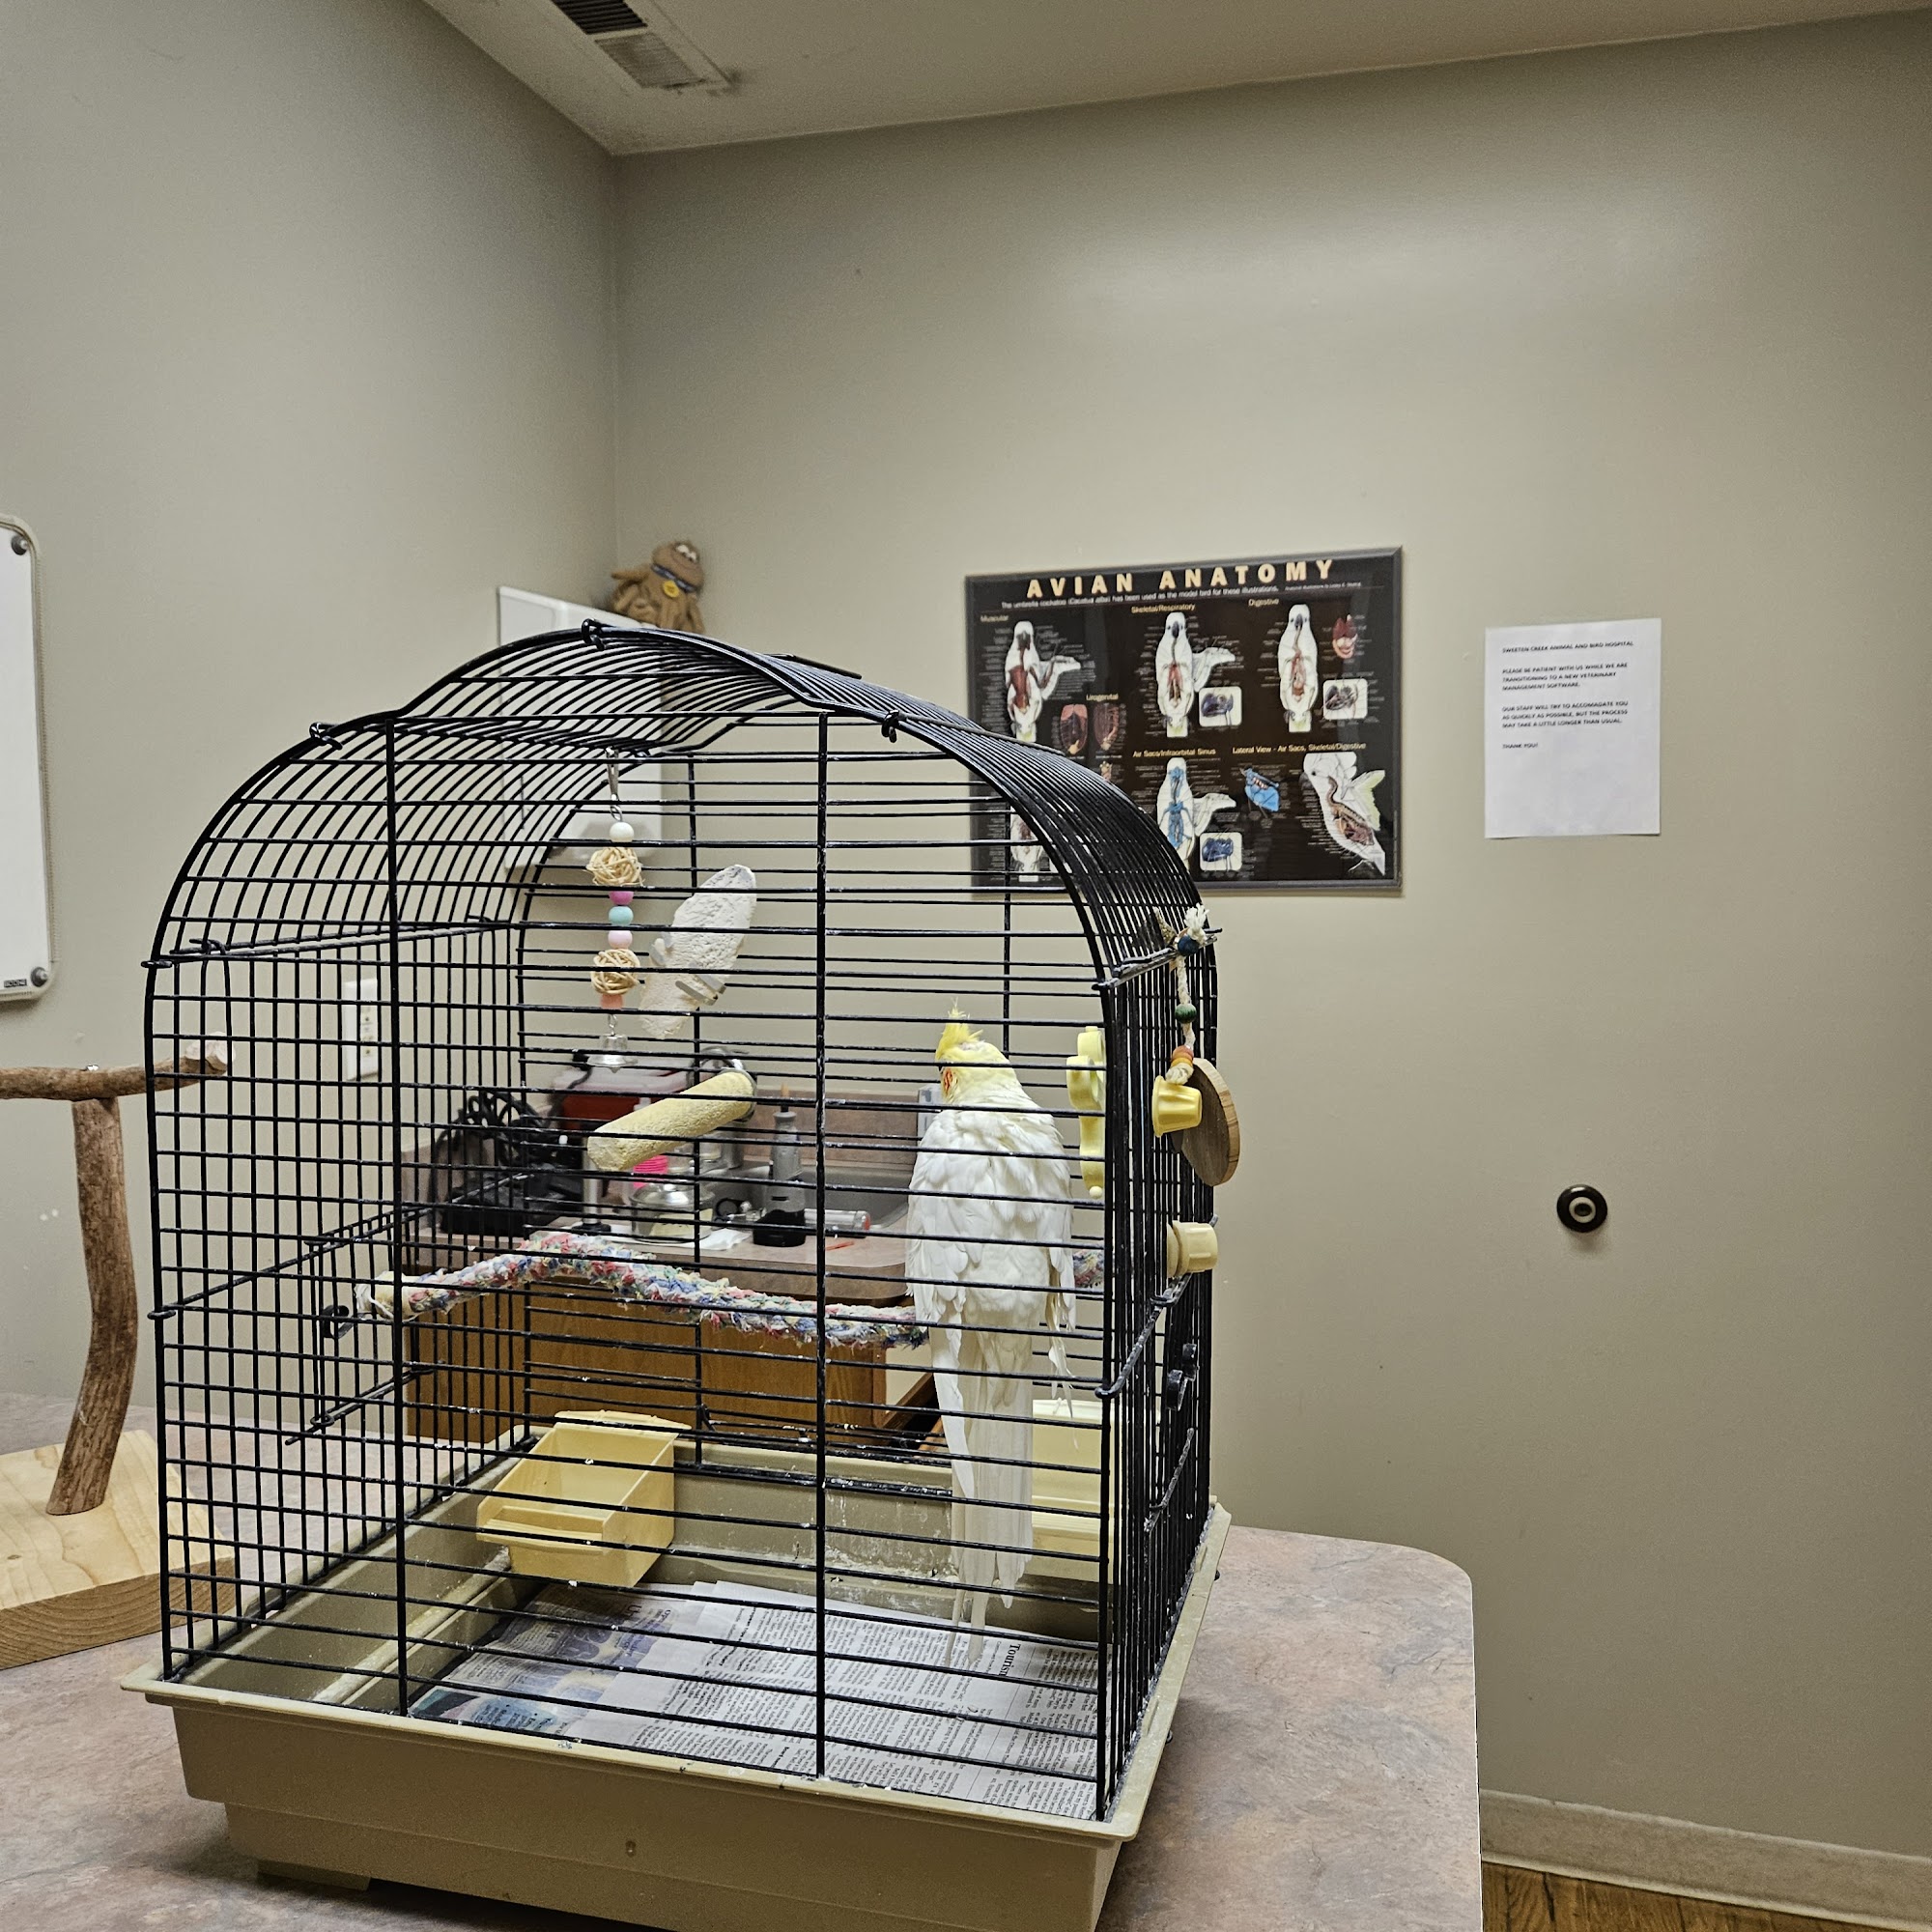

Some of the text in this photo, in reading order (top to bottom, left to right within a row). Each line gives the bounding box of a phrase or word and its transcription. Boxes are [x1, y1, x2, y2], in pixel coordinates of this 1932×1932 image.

[1027, 559, 1332, 598] AVIAN ANATOMY
[1241, 585, 1279, 594] illustrations.
[1249, 598, 1280, 607] Digestive
[1131, 604, 1196, 613] Skeletal/Respiratory
[980, 614, 1009, 623] Muscular
[1086, 693, 1119, 702] Urogenital
[1233, 746, 1255, 754] Lateral
[1289, 744, 1306, 753] Sacs,
[1308, 742, 1367, 752] Skeletal/Digestive
